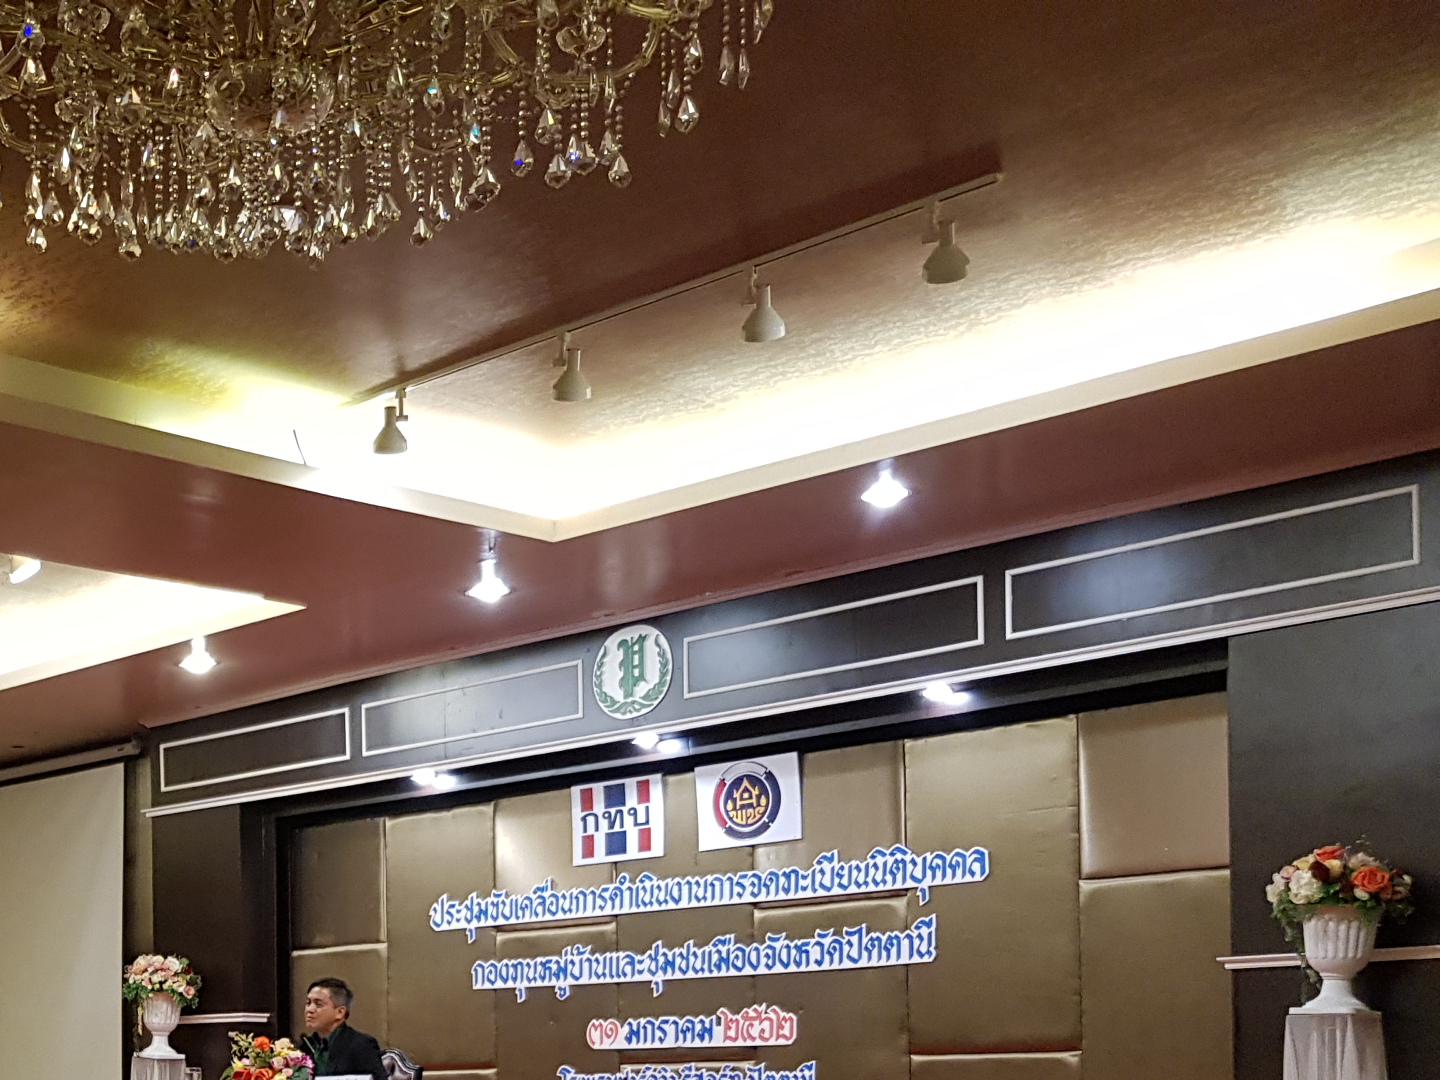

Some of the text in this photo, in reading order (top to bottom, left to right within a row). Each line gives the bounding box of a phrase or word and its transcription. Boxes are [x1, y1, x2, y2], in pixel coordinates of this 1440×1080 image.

[580, 805, 650, 834] กทบ
[588, 1004, 796, 1046] ๓๑ มกราคม ๒๕๖๒
